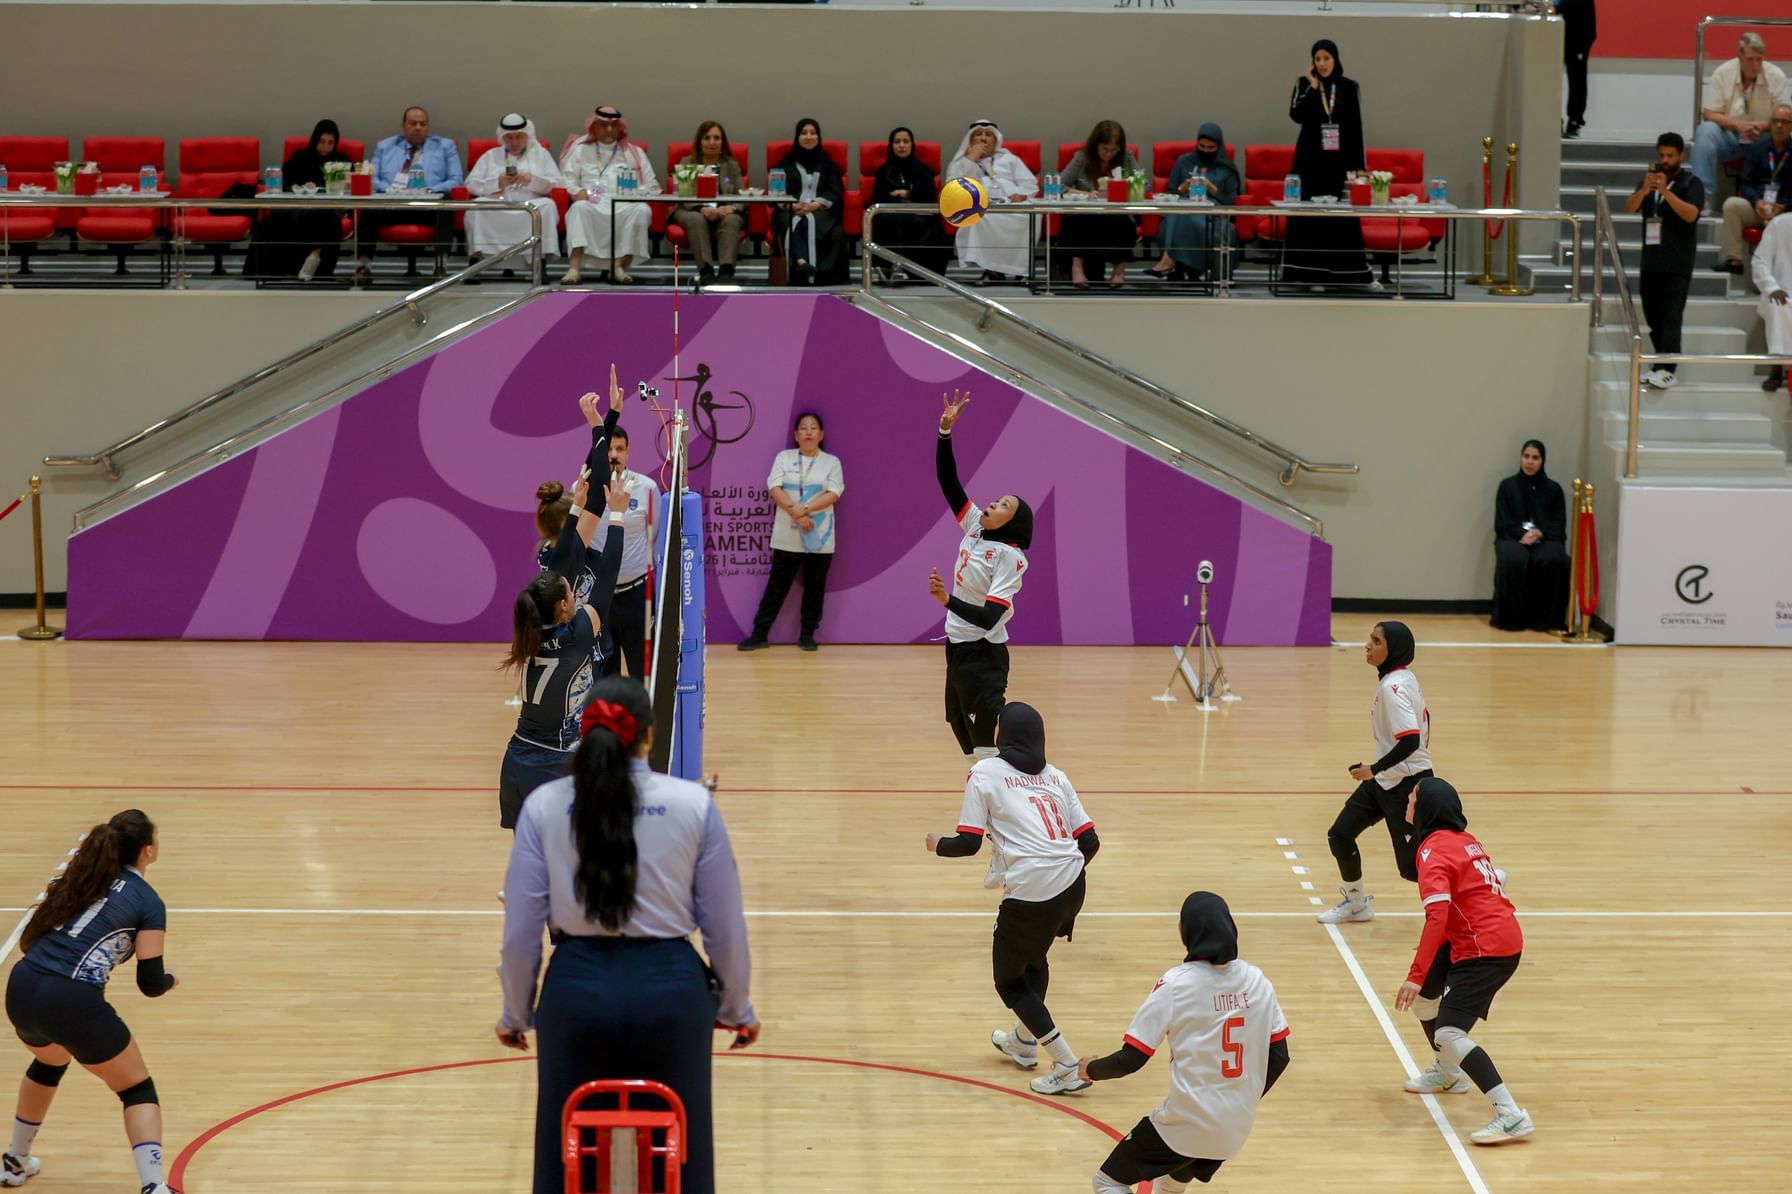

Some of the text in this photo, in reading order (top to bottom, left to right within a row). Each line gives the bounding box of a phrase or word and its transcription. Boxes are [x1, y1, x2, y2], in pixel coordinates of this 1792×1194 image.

[748, 486, 773, 501] ورة
[704, 535, 773, 551] AMENT
[683, 561, 693, 606] Senoh
[521, 656, 560, 706] 17
[1028, 794, 1068, 841] 11
[1221, 1016, 1245, 1079] 5
